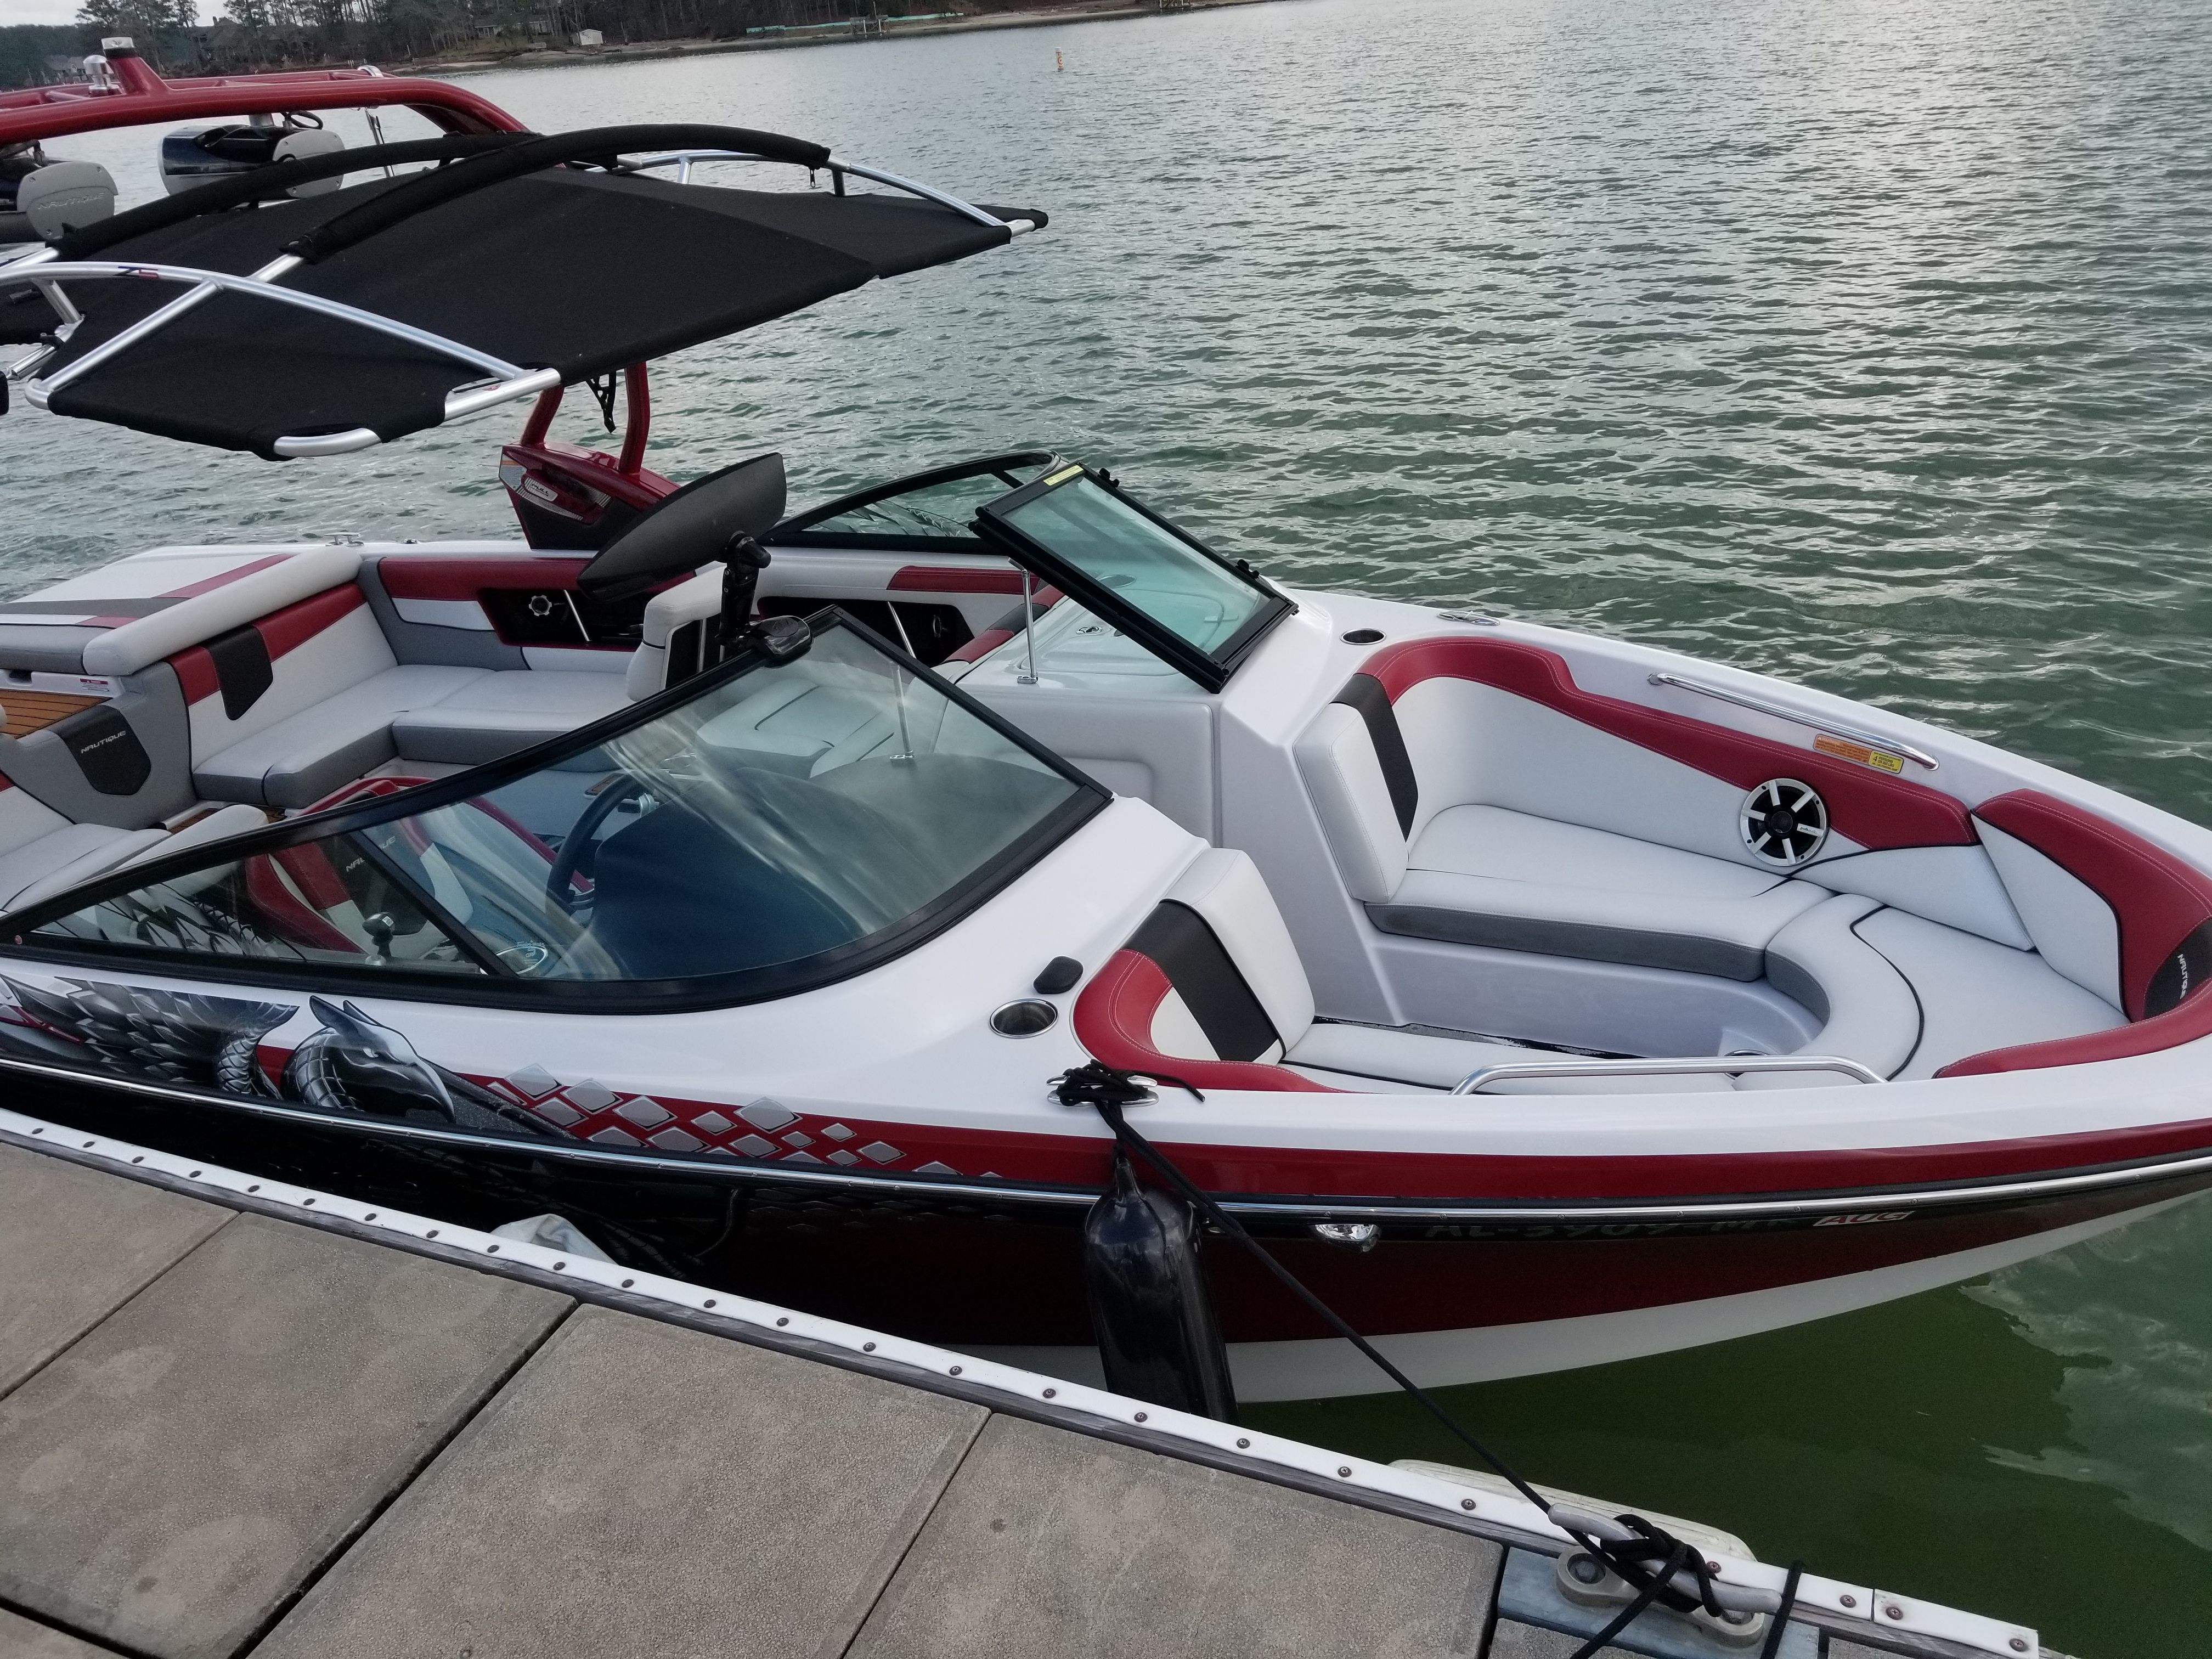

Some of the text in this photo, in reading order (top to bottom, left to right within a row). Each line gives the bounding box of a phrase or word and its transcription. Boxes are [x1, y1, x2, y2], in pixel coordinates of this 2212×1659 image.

[37, 192, 105, 210] NAUTIQUE
[81, 730, 126, 754] NAUTIQUE
[1818, 1211, 1908, 1225] AUG
